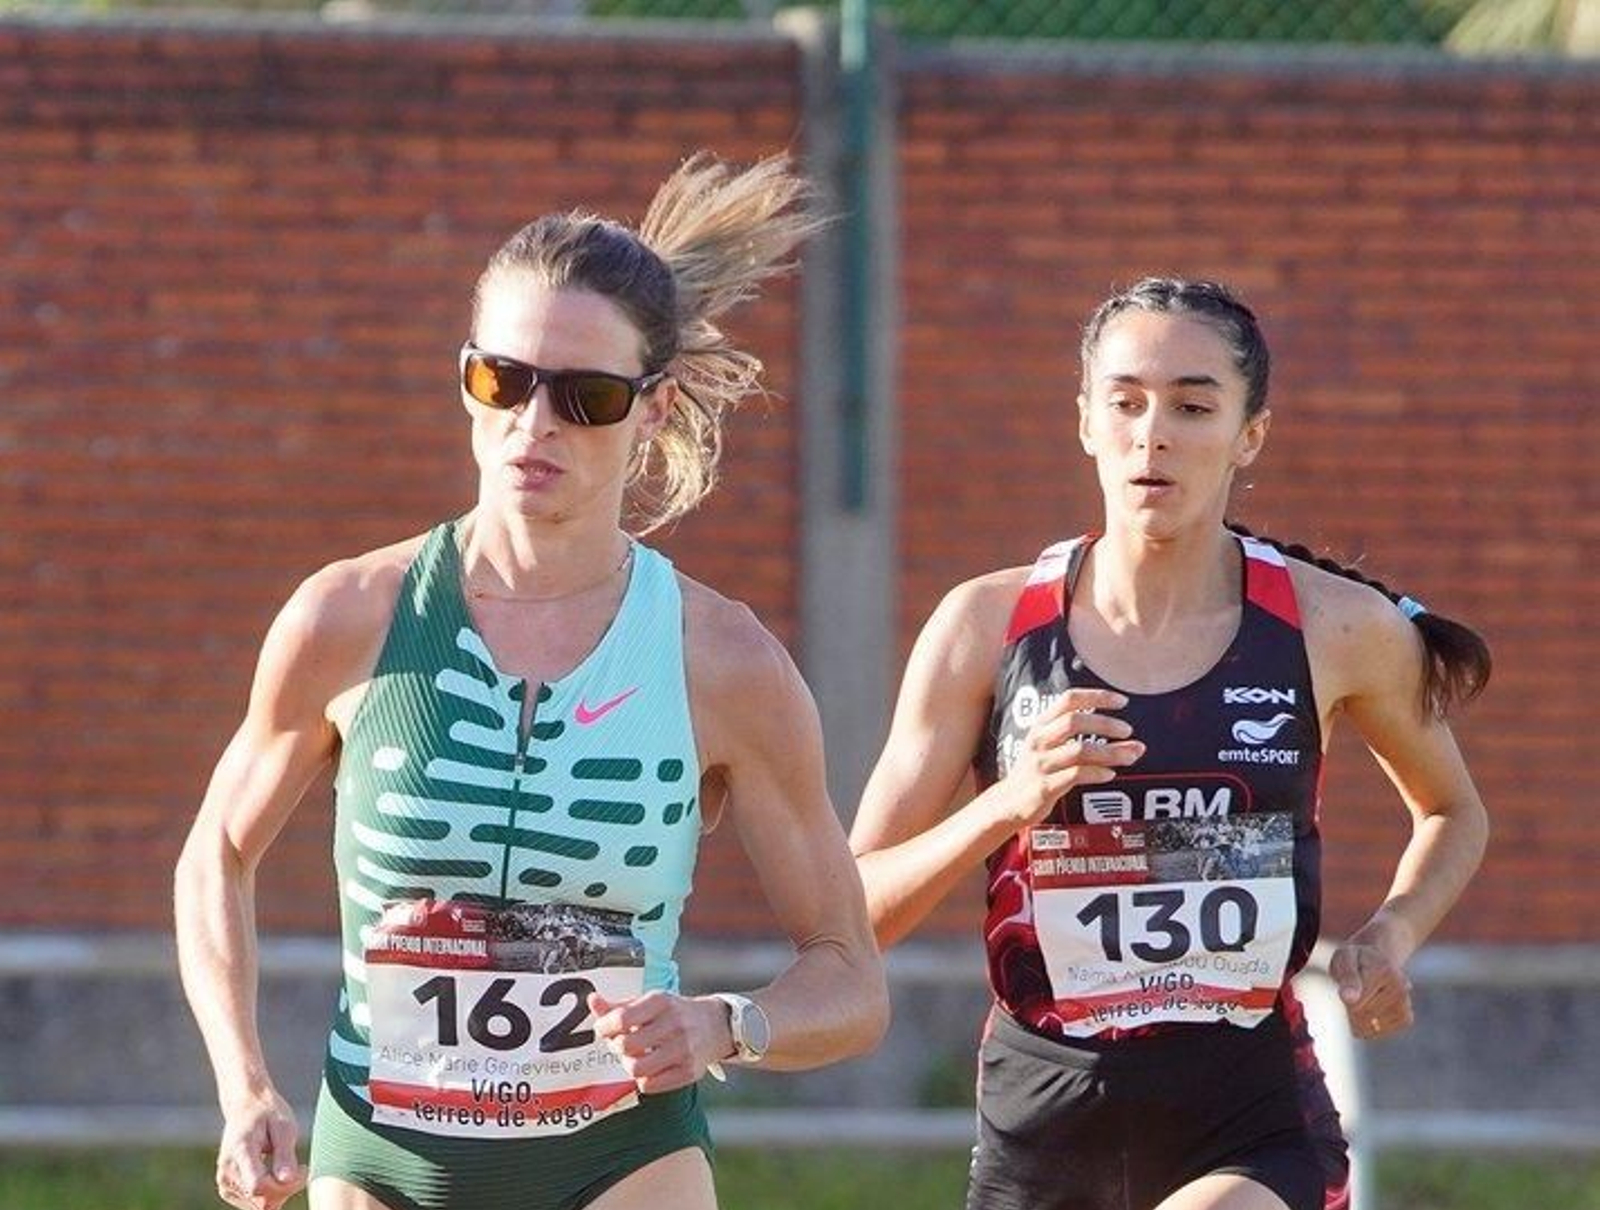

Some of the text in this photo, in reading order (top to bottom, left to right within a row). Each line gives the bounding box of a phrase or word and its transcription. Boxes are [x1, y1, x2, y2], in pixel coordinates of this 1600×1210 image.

[1217, 747, 1300, 765] emteSPORT
[1075, 886, 1259, 964] 130
[412, 975, 597, 1053] 162
[415, 1101, 594, 1128] terreo de xogo
